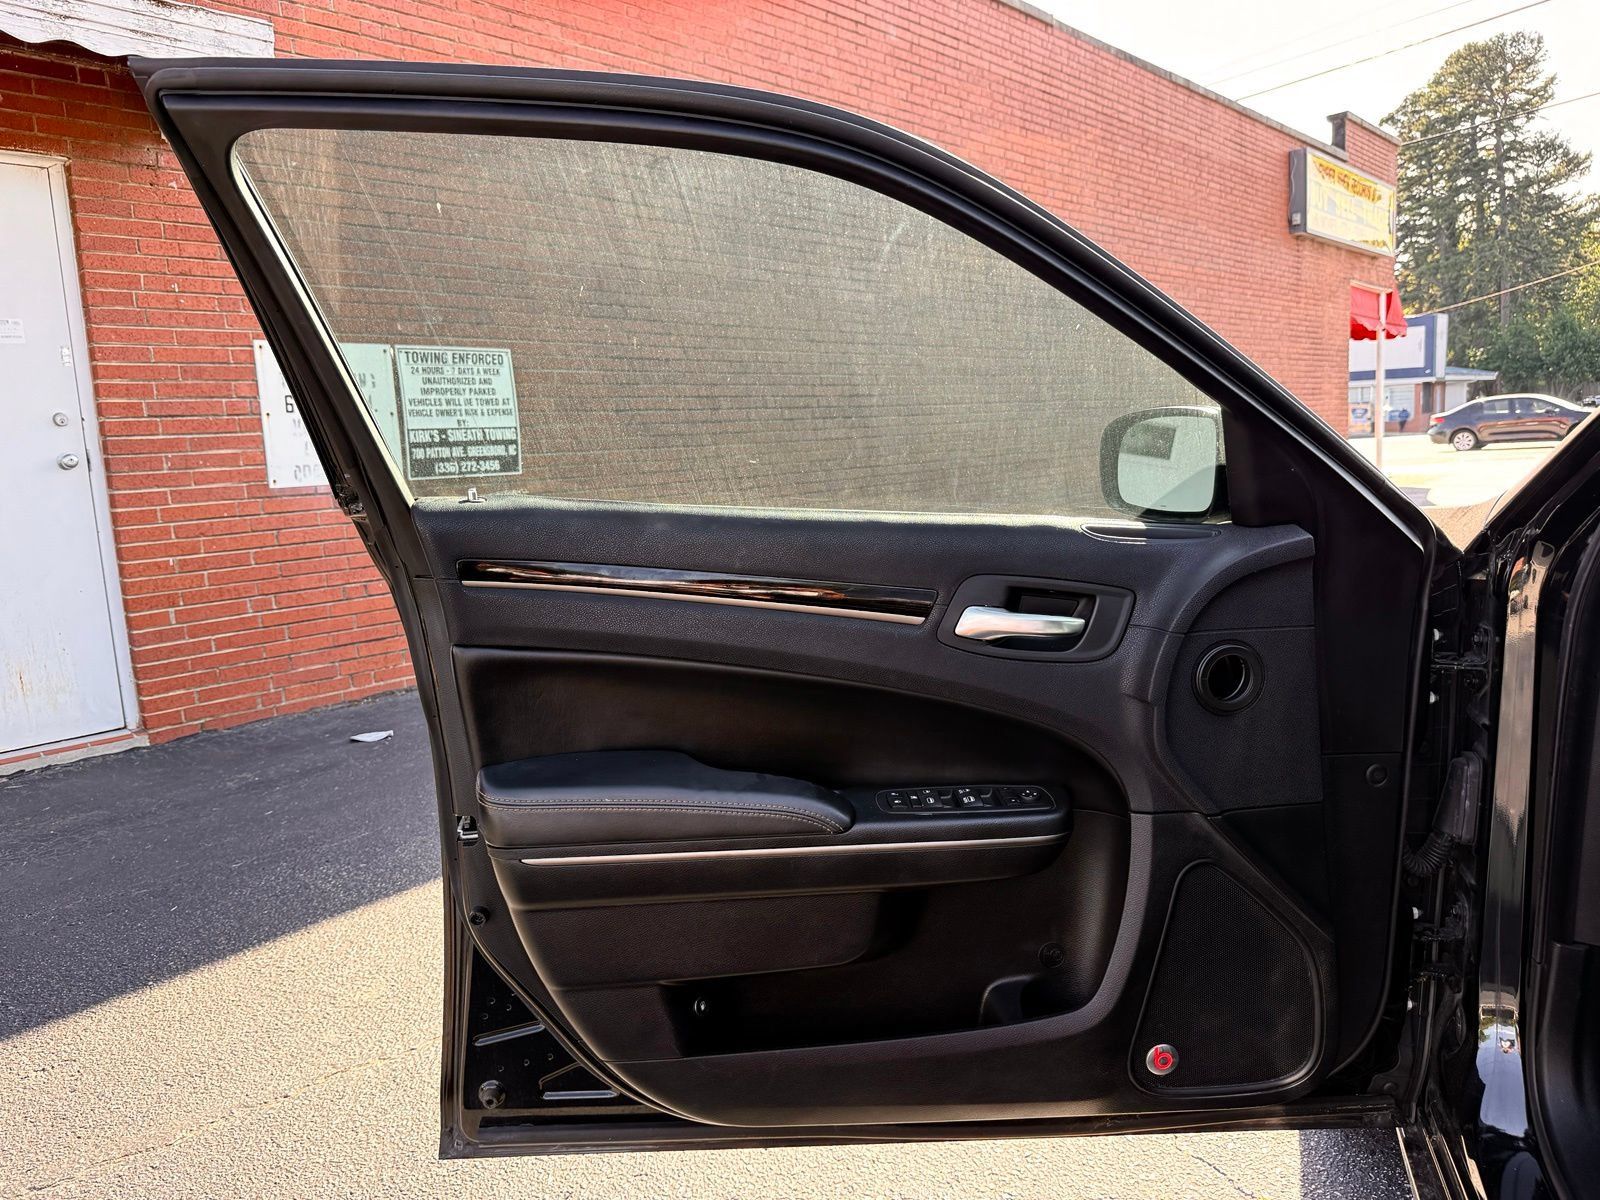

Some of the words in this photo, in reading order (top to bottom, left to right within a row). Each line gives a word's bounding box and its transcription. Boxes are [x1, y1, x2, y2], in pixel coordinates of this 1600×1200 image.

[404, 351, 448, 365] TOWING
[452, 352, 504, 366] ENFORCED
[410, 366, 420, 375] 24
[421, 366, 445, 375] HOURS
[458, 367, 475, 376] DAYS
[483, 368, 501, 376] WEEK
[421, 376, 477, 386] UNAUTHORIZED
[479, 377, 493, 386] AND
[420, 387, 467, 396] IMPROPERLY
[469, 387, 497, 396] PARKED
[408, 398, 443, 407] VEHICLES
[445, 398, 463, 407] WILL
[475, 397, 500, 406] TOWED
[502, 397, 511, 406] AT
[408, 408, 434, 417] VEHICLE
[435, 408, 463, 417] OWNER'S
[486, 408, 514, 416] EXPENSE
[457, 419, 470, 427] BY:
[409, 429, 440, 443] KIRK'S
[483, 427, 517, 441] TOWING
[435, 460, 459, 475] (336)
